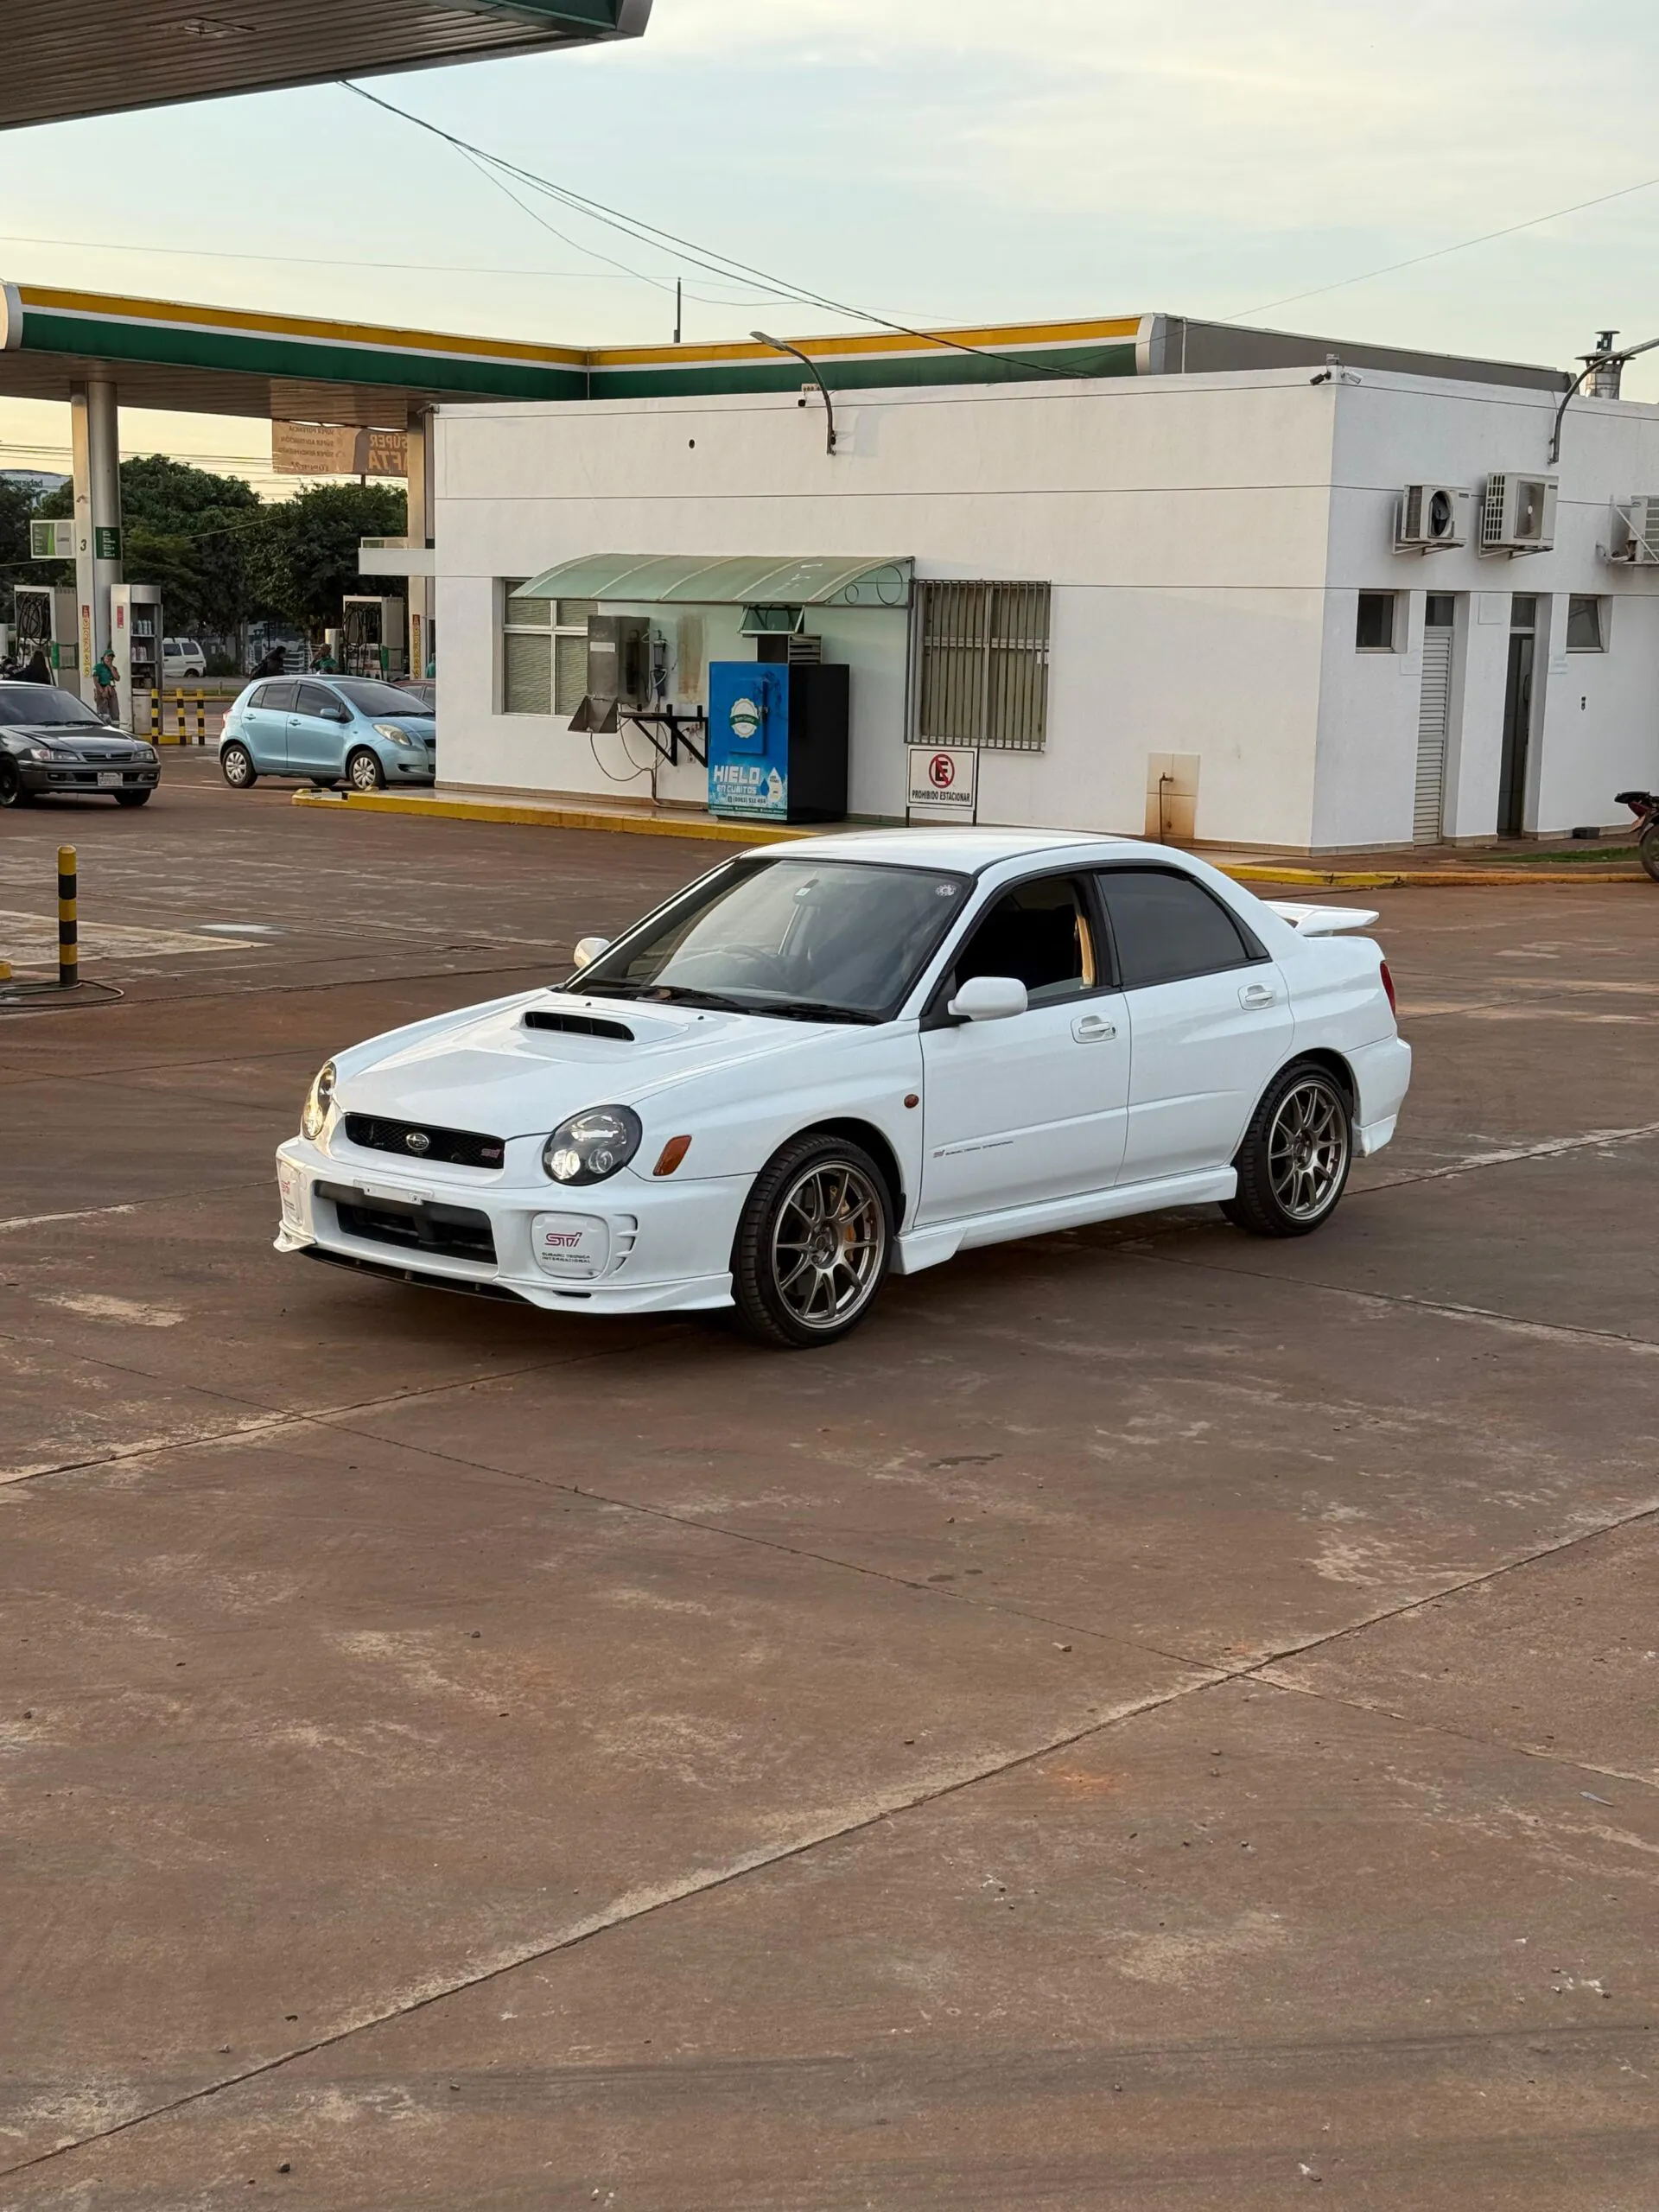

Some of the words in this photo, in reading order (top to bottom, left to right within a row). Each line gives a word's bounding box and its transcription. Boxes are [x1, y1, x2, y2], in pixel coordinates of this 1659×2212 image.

[79, 539, 87, 551] 3
[713, 765, 760, 785] HIELO
[912, 790, 938, 800] PROHIBIDO
[939, 791, 970, 802] ESTACIONAR
